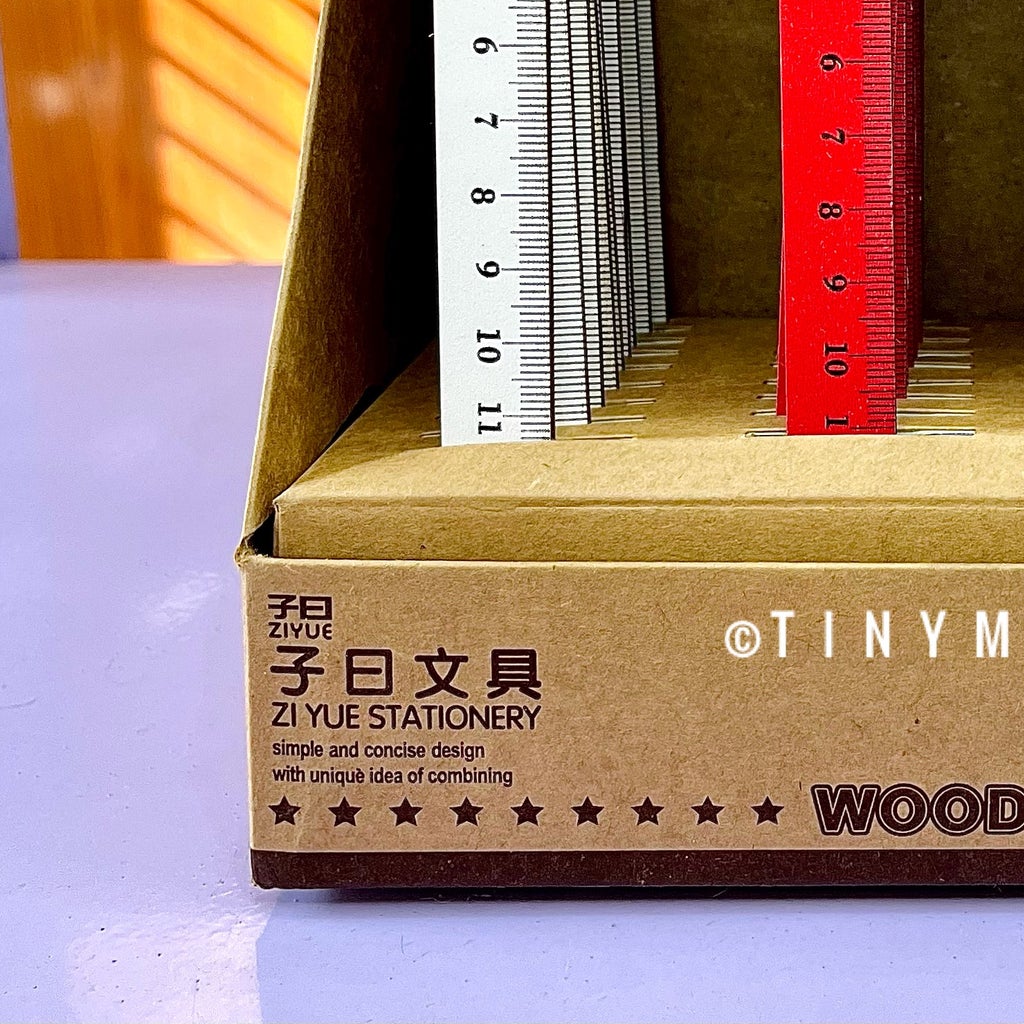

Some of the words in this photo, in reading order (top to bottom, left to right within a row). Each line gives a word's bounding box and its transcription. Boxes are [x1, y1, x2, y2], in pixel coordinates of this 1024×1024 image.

[472, 36, 499, 55] 6
[819, 53, 844, 71] 6
[474, 112, 499, 129] 7
[821, 128, 846, 145] 7
[470, 187, 496, 205] 8
[818, 202, 843, 220] 8
[475, 260, 501, 278] 9
[823, 274, 848, 293] 9
[476, 329, 503, 364] 10
[824, 342, 849, 377] 10
[477, 402, 503, 435] 11
[267, 621, 333, 641] ZIYUE
[271, 701, 297, 728] ZI
[305, 703, 360, 729] YUE
[368, 704, 542, 730] STATIONERY
[272, 739, 324, 760] simple
[328, 740, 359, 758] and
[364, 741, 426, 759] concise
[431, 741, 485, 762] design
[272, 765, 306, 783] with
[369, 766, 403, 784] idea
[407, 766, 425, 784] of
[428, 766, 513, 788] combining
